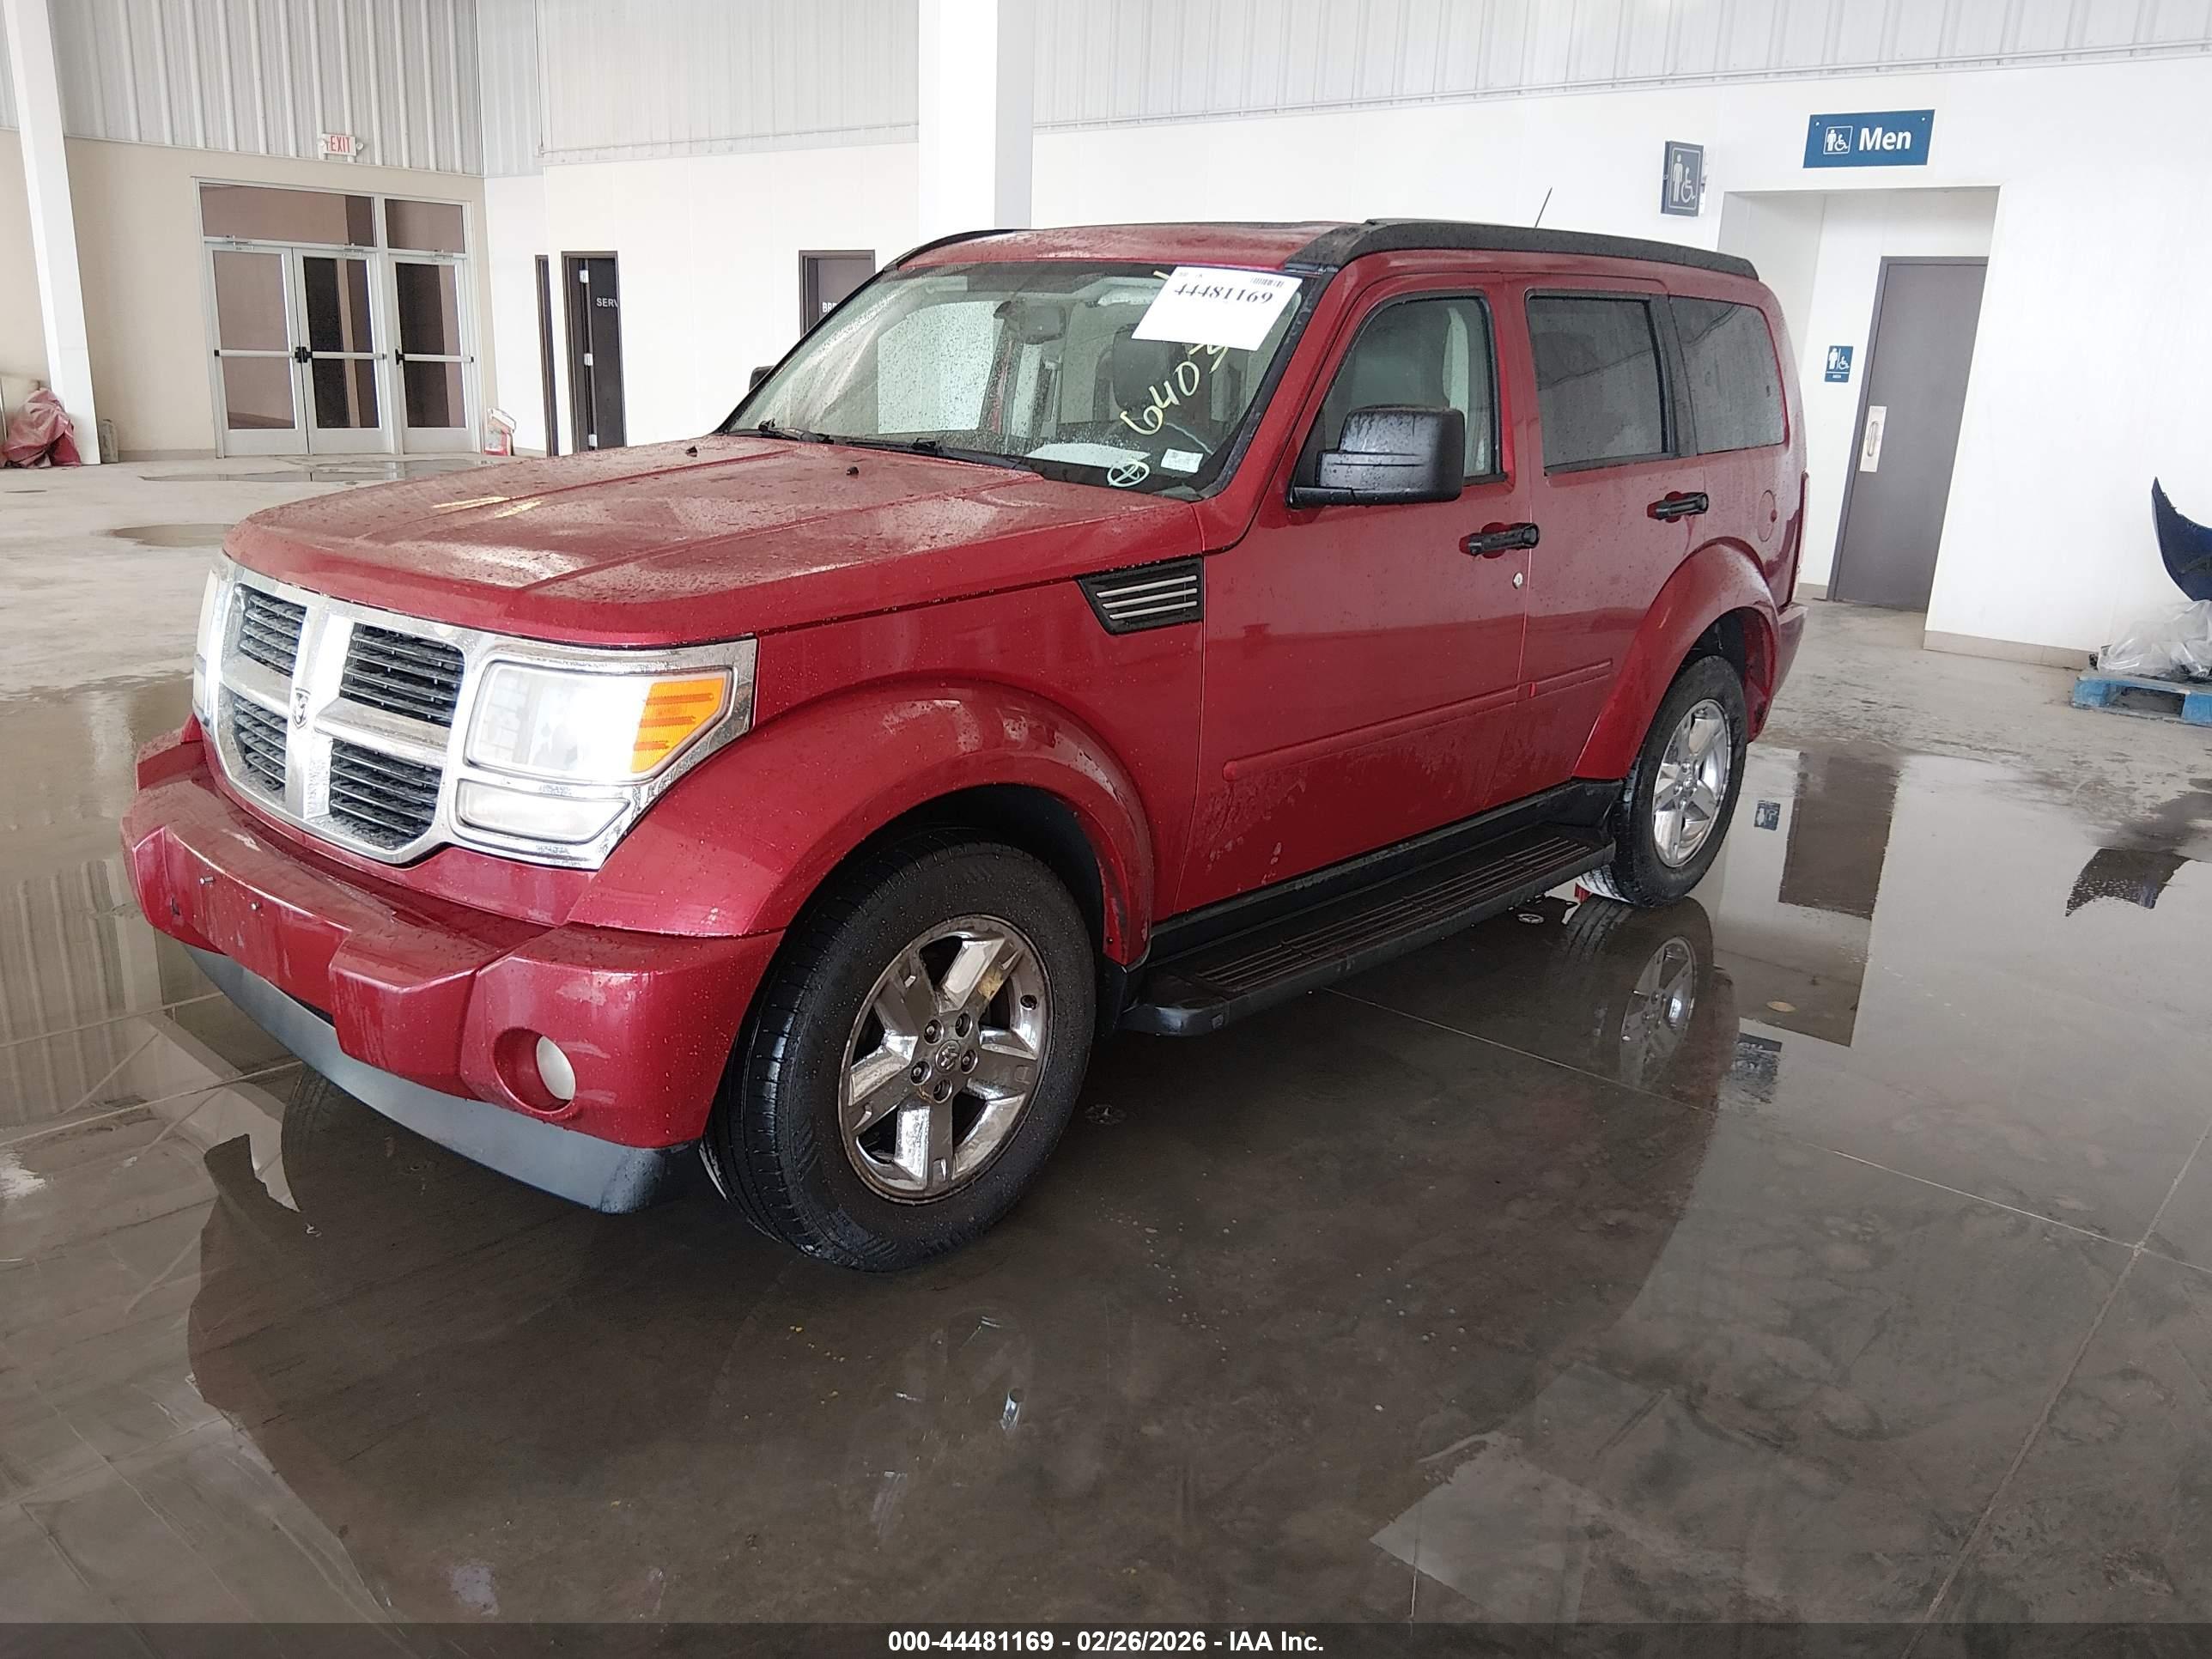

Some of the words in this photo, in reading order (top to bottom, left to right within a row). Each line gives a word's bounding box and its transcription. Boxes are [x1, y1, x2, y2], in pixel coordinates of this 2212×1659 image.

[330, 136, 350, 153] EXIT
[1858, 127, 1911, 151] Men
[1174, 283, 1273, 304] 44481169
